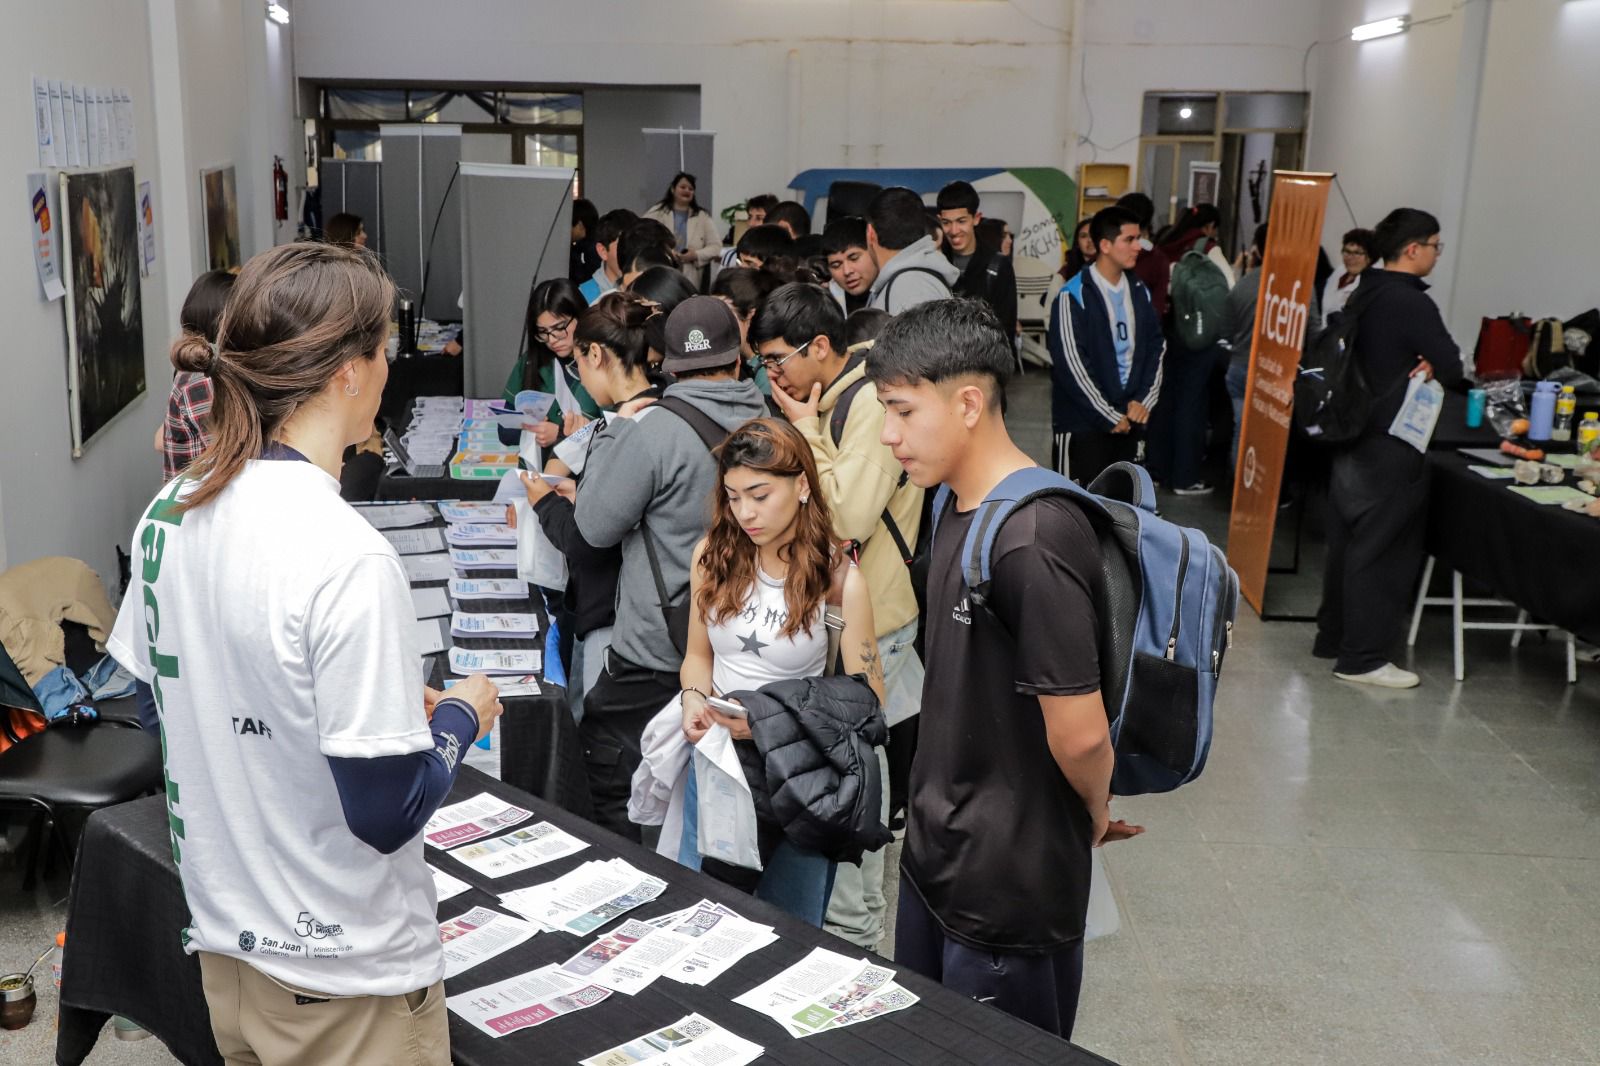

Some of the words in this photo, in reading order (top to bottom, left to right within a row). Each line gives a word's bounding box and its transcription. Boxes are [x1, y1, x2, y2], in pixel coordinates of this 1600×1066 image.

[1261, 272, 1307, 351] fcefn
[259, 946, 290, 958] Gobierno
[261, 936, 278, 948] San
[279, 941, 302, 953] Juan
